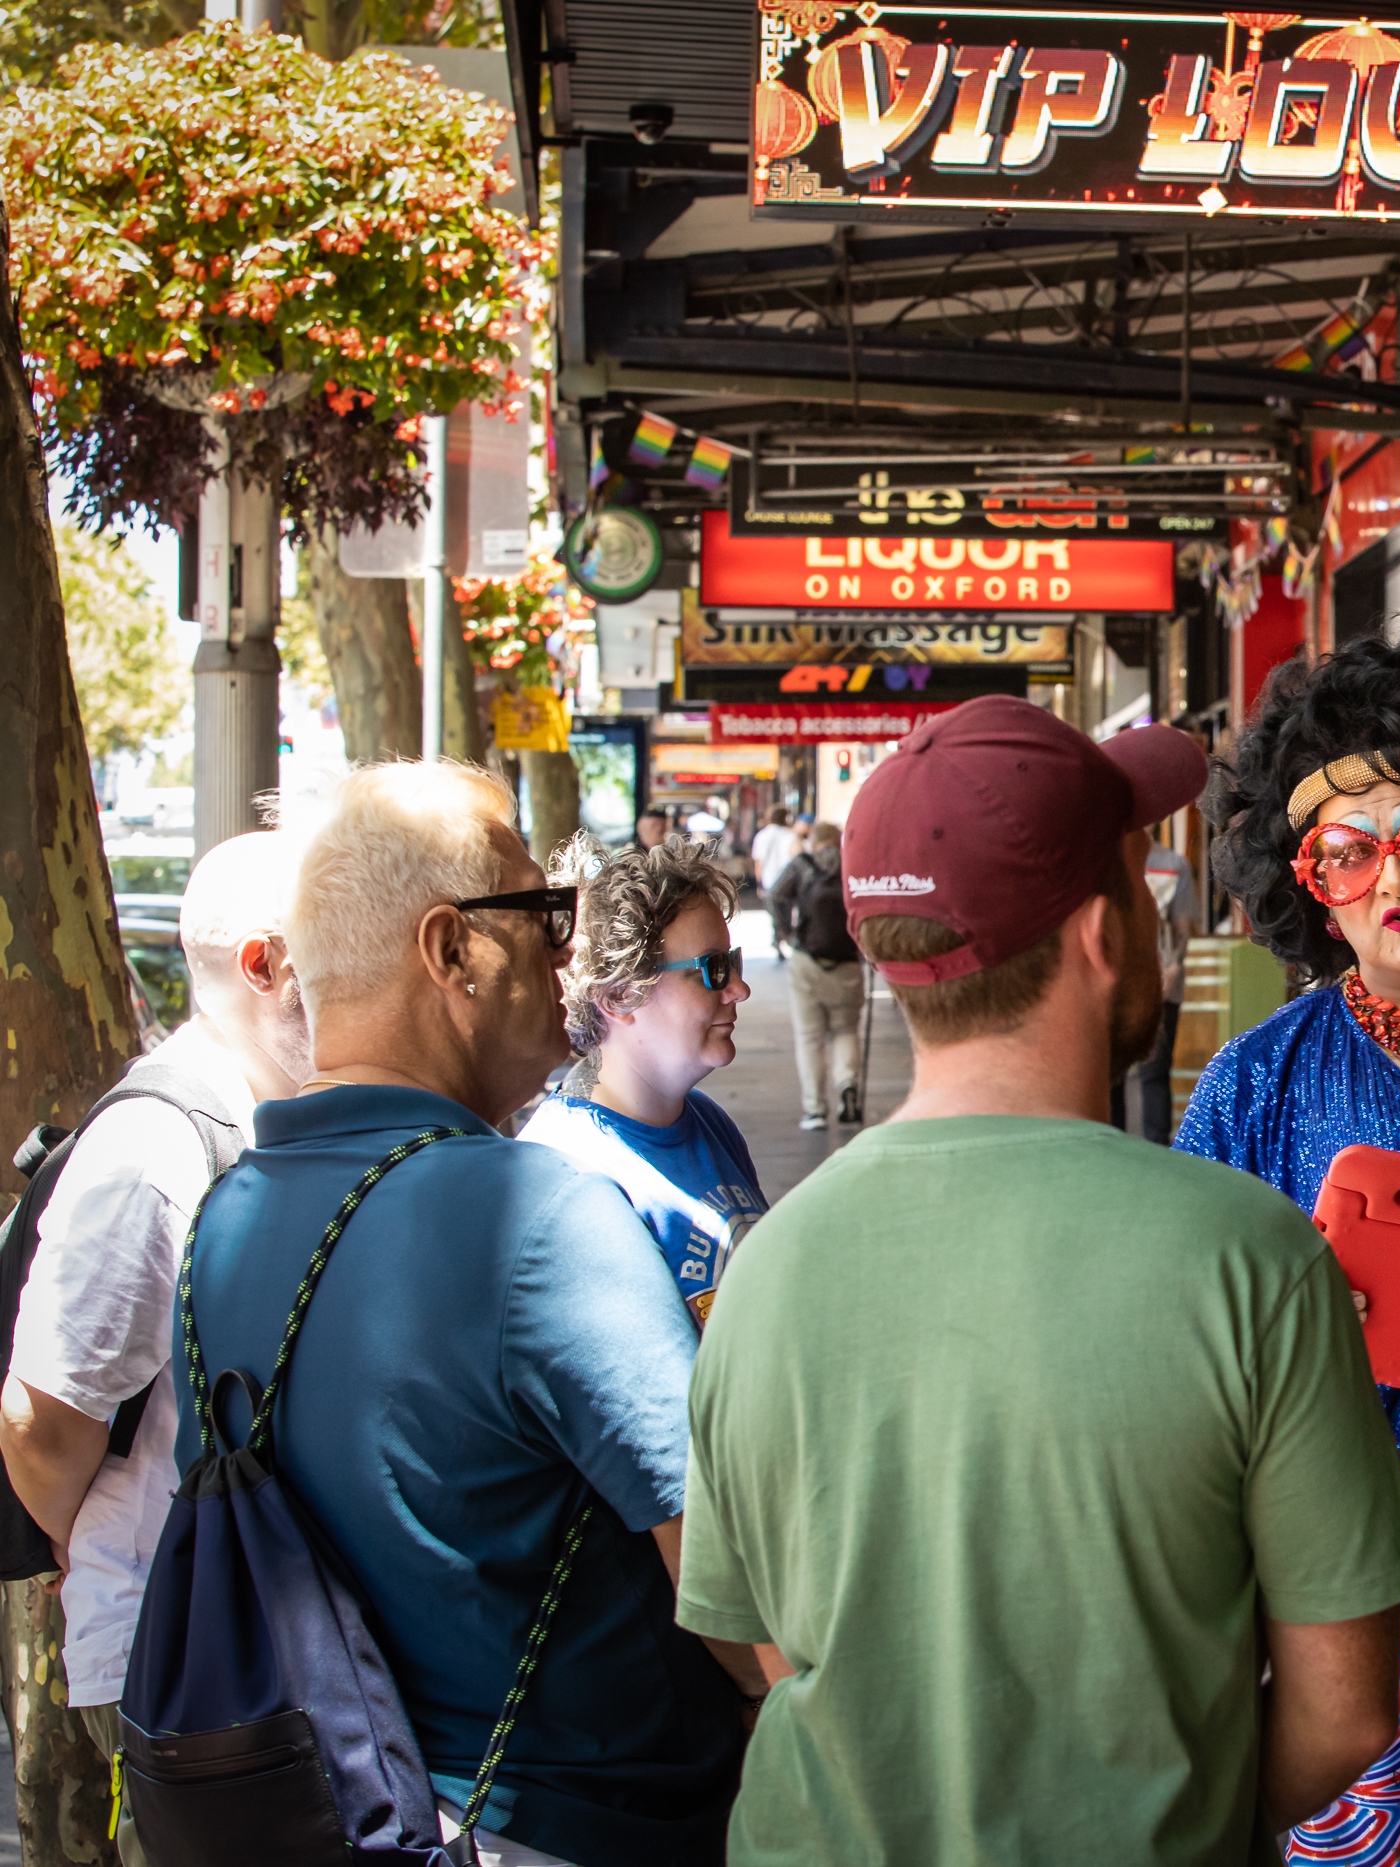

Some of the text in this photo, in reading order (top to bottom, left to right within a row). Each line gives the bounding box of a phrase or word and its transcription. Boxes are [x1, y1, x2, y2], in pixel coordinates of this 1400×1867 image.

[836, 42, 1124, 180] VIP
[806, 537, 1070, 574] LIQUOR
[805, 573, 1072, 602] ON OXFORD
